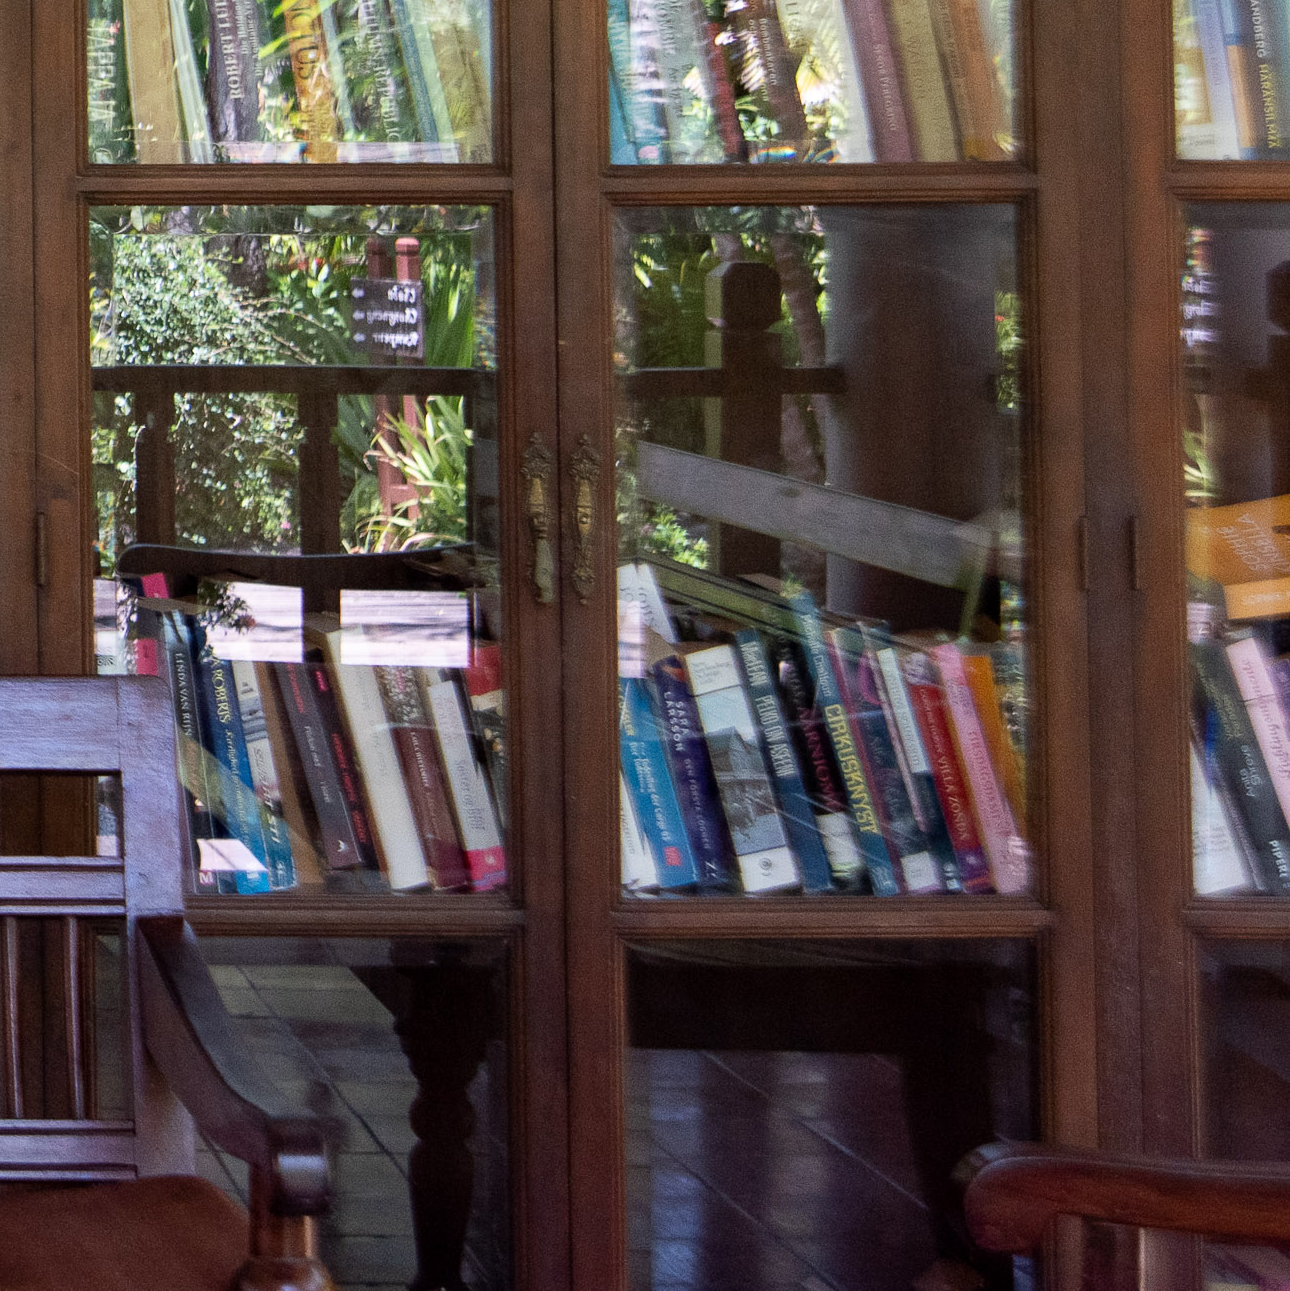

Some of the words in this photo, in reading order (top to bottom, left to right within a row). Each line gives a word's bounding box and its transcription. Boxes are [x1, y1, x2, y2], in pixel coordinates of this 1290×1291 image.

[217, 30, 245, 100] ROBERT
[757, 18, 779, 87] Bombmakaren
[176, 652, 190, 688] LINDA
[738, 641, 767, 686] MacLEAN
[179, 689, 192, 711] VAN
[181, 712, 194, 736] RIJN
[209, 669, 231, 724] ROBERTS
[663, 691, 685, 753] LARSSON
[676, 700, 690, 737] SARA
[825, 704, 880, 835] CIRKUSKNYST
[937, 756, 954, 792] VILLA
[947, 795, 969, 841] ZONDA
